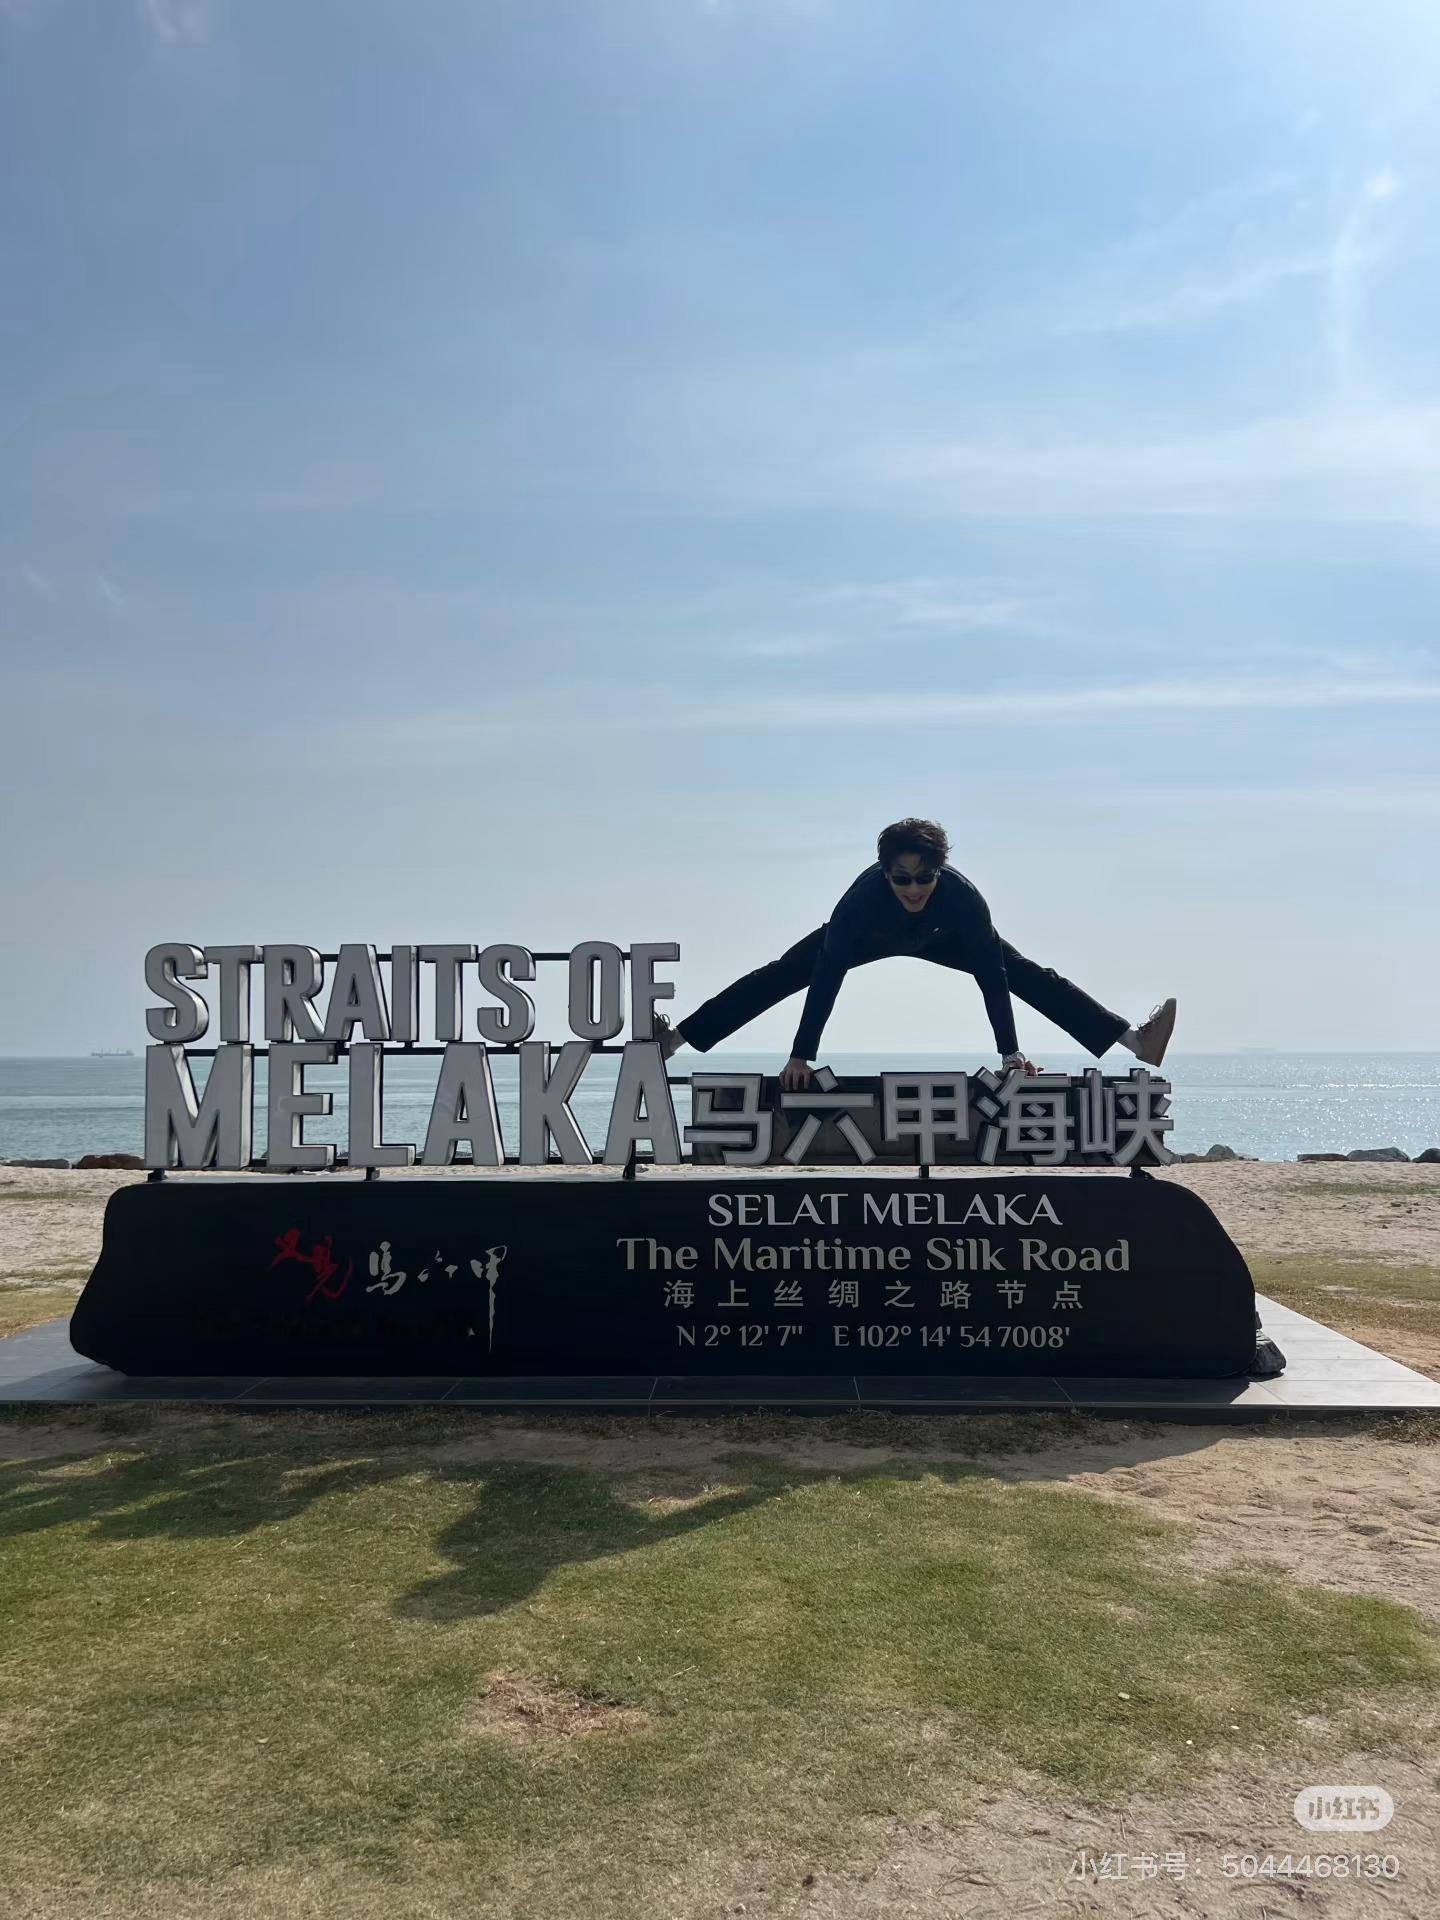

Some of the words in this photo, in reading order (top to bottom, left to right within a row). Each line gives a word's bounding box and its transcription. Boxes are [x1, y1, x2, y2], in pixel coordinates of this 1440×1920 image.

[145, 943, 537, 1042] STRAITS
[568, 940, 680, 1041] OF
[145, 1041, 683, 1167] MELAKA
[684, 1067, 1174, 1167] 马六甲海峡
[708, 1193, 849, 1227] SELAT
[863, 1192, 1064, 1227] MELAKA
[616, 1237, 698, 1270] The
[714, 1237, 911, 1272] Maritime
[926, 1237, 1007, 1271] Silk
[1018, 1237, 1130, 1272] Road
[663, 1279, 1083, 1310] 海上丝绸之路节点
[677, 1325, 695, 1347] N
[704, 1325, 731, 1347] 2°
[739, 1325, 769, 1347] 12'
[833, 1325, 850, 1347] E
[857, 1325, 912, 1347] 102°
[919, 1325, 951, 1348] 14'
